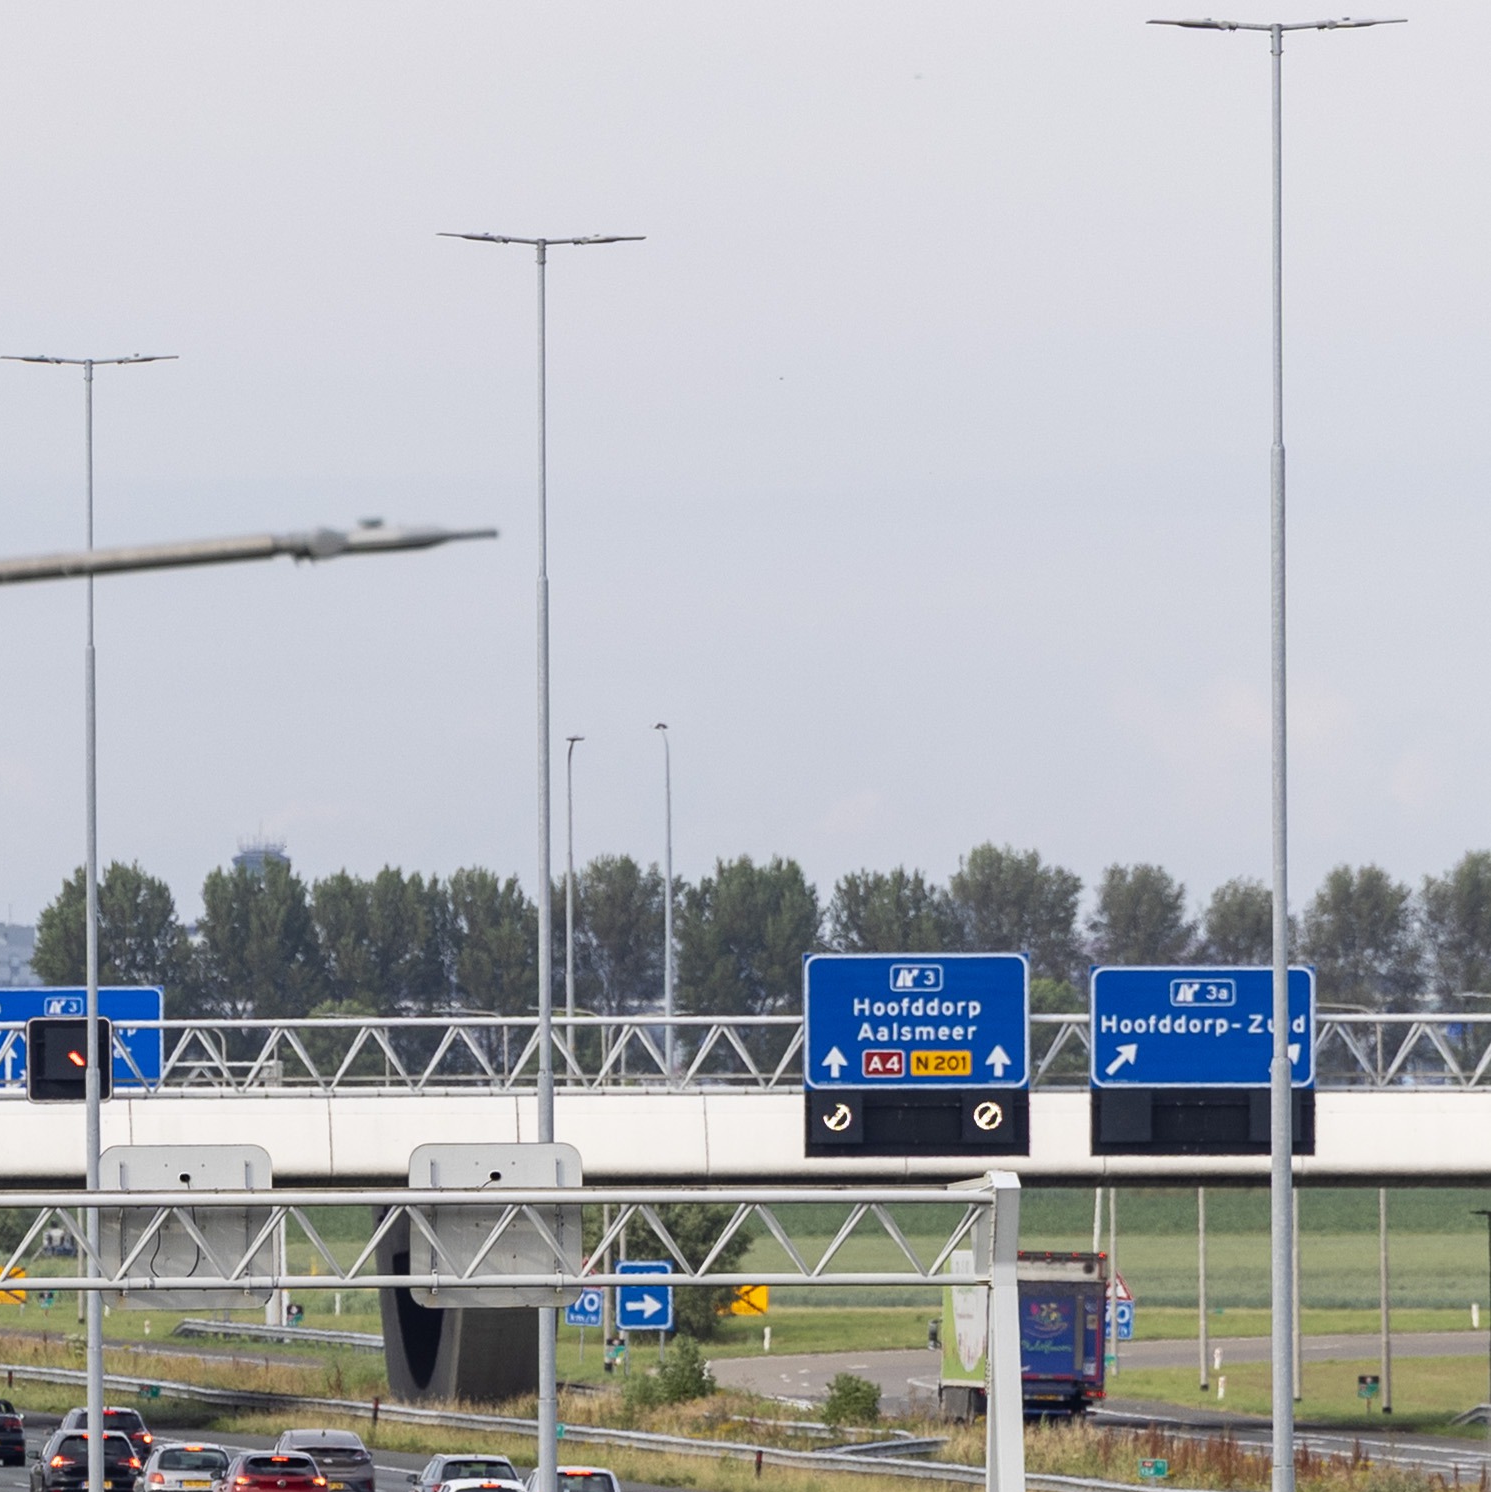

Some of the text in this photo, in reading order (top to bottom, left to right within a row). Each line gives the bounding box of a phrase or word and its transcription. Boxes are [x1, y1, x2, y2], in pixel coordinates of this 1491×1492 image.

[923, 971, 936, 986] 3
[1205, 984, 1229, 1000] 3a
[852, 998, 982, 1019] Hoofddorp
[856, 1022, 978, 1042] Aalsmeer
[867, 1055, 901, 1072] A4
[915, 1055, 967, 1071] N 201
